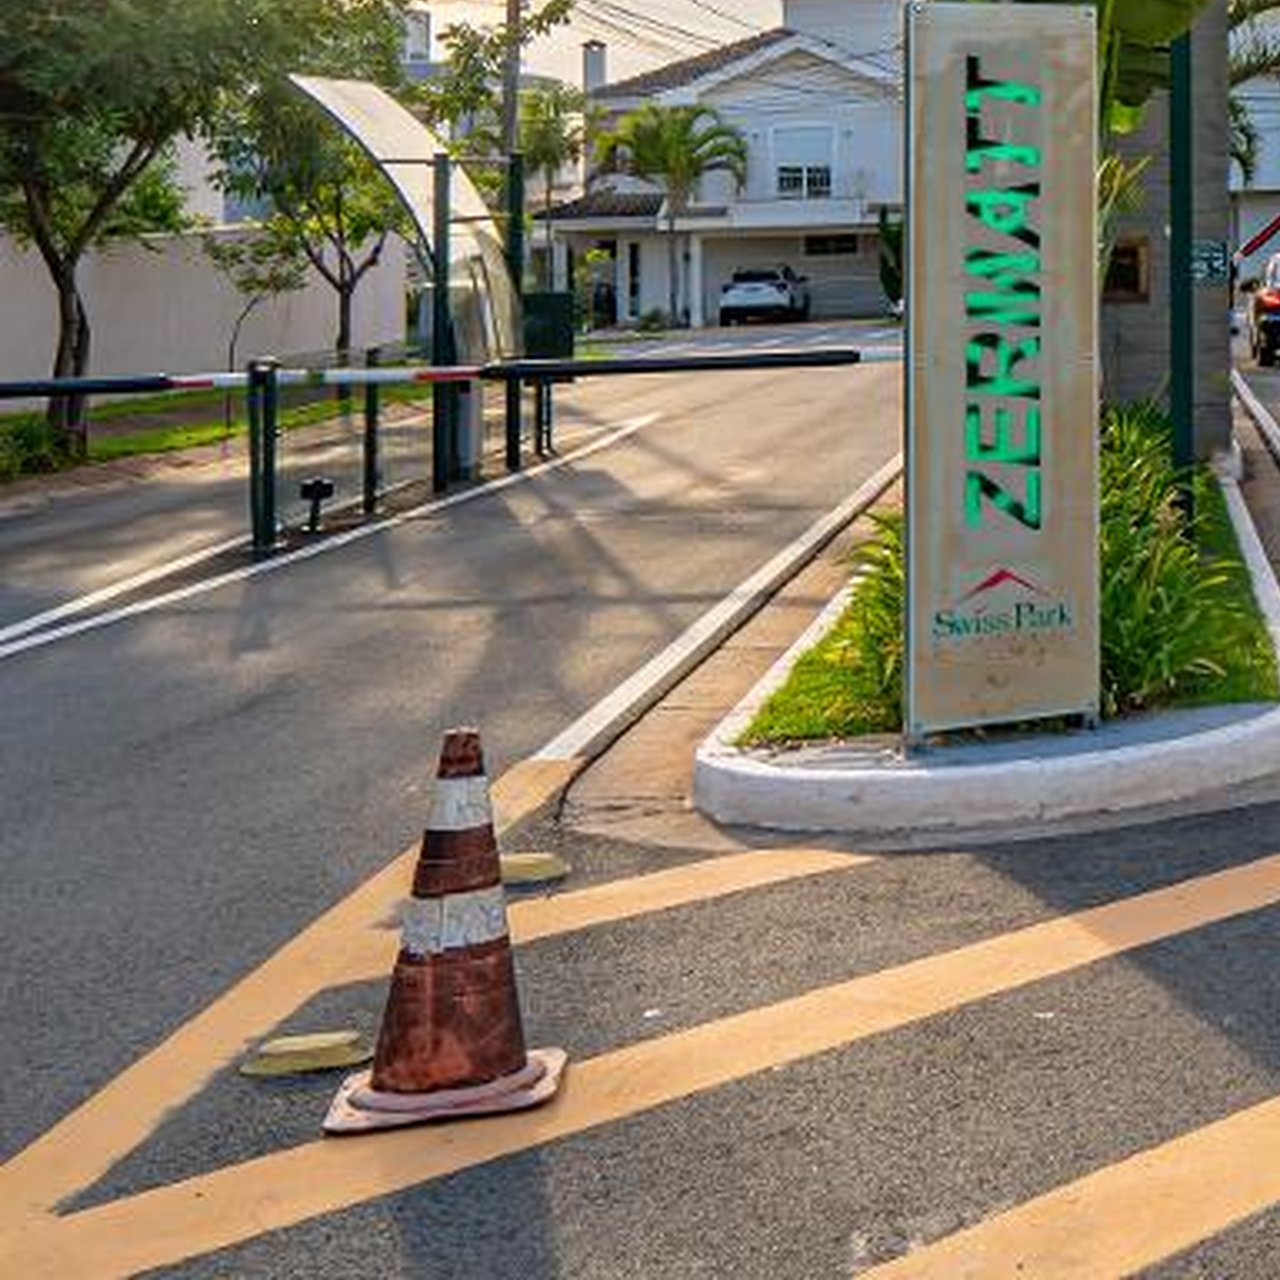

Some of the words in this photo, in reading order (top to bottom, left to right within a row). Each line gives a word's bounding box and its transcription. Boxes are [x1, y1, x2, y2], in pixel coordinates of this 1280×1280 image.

[965, 55, 1041, 530] ZERMATT
[932, 608, 1012, 638] Swiss
[1014, 602, 1071, 630] Park
